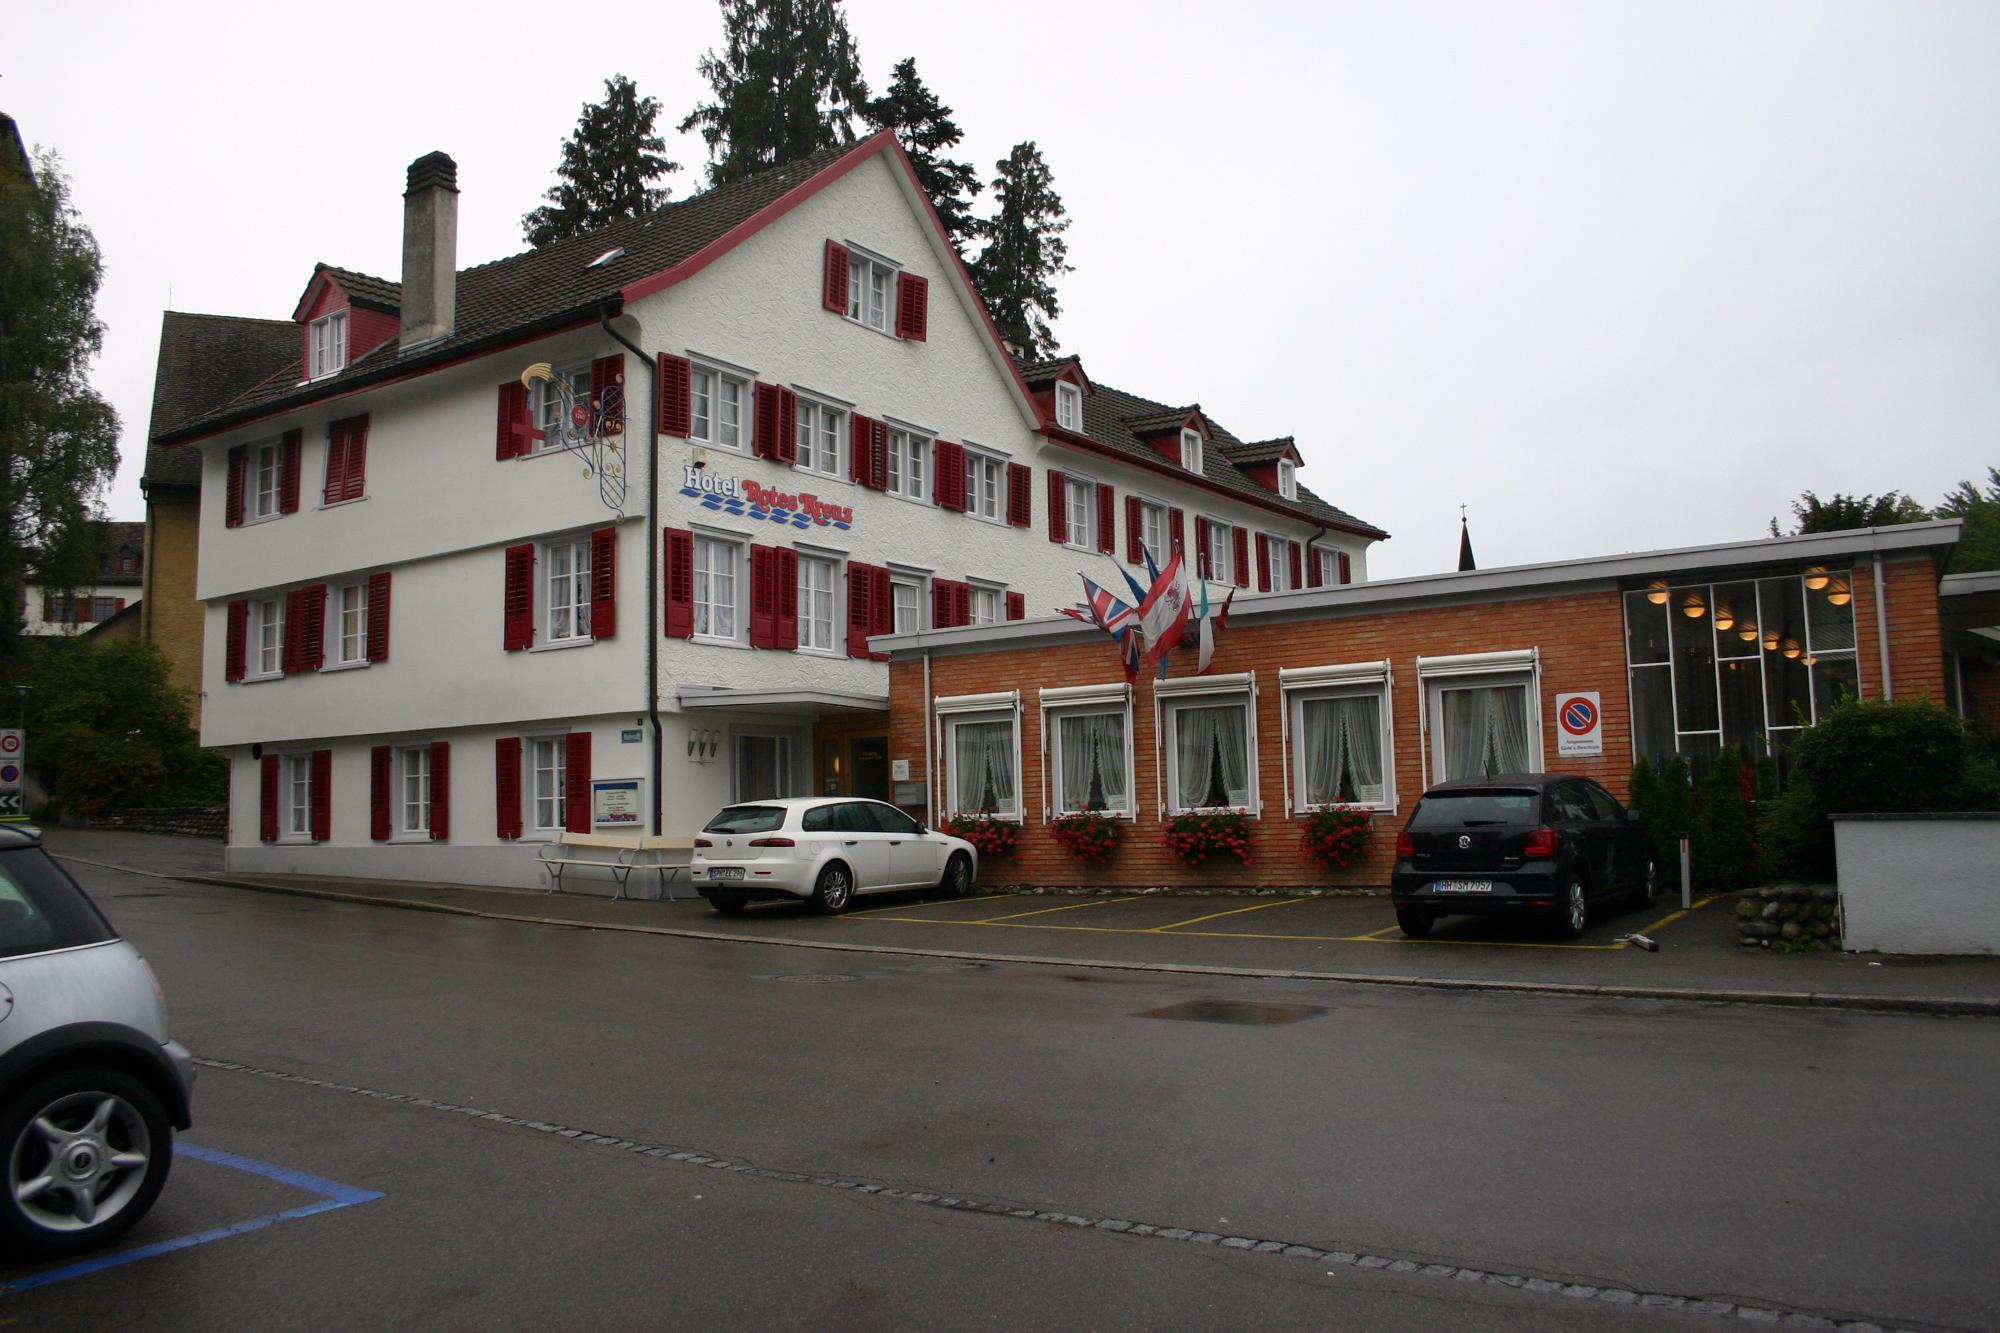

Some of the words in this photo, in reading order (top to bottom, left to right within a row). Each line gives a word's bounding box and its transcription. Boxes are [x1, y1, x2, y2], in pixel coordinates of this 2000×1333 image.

[684, 465, 739, 498] Hotel
[742, 479, 799, 513] Rotes
[799, 491, 853, 526] Kreuz
